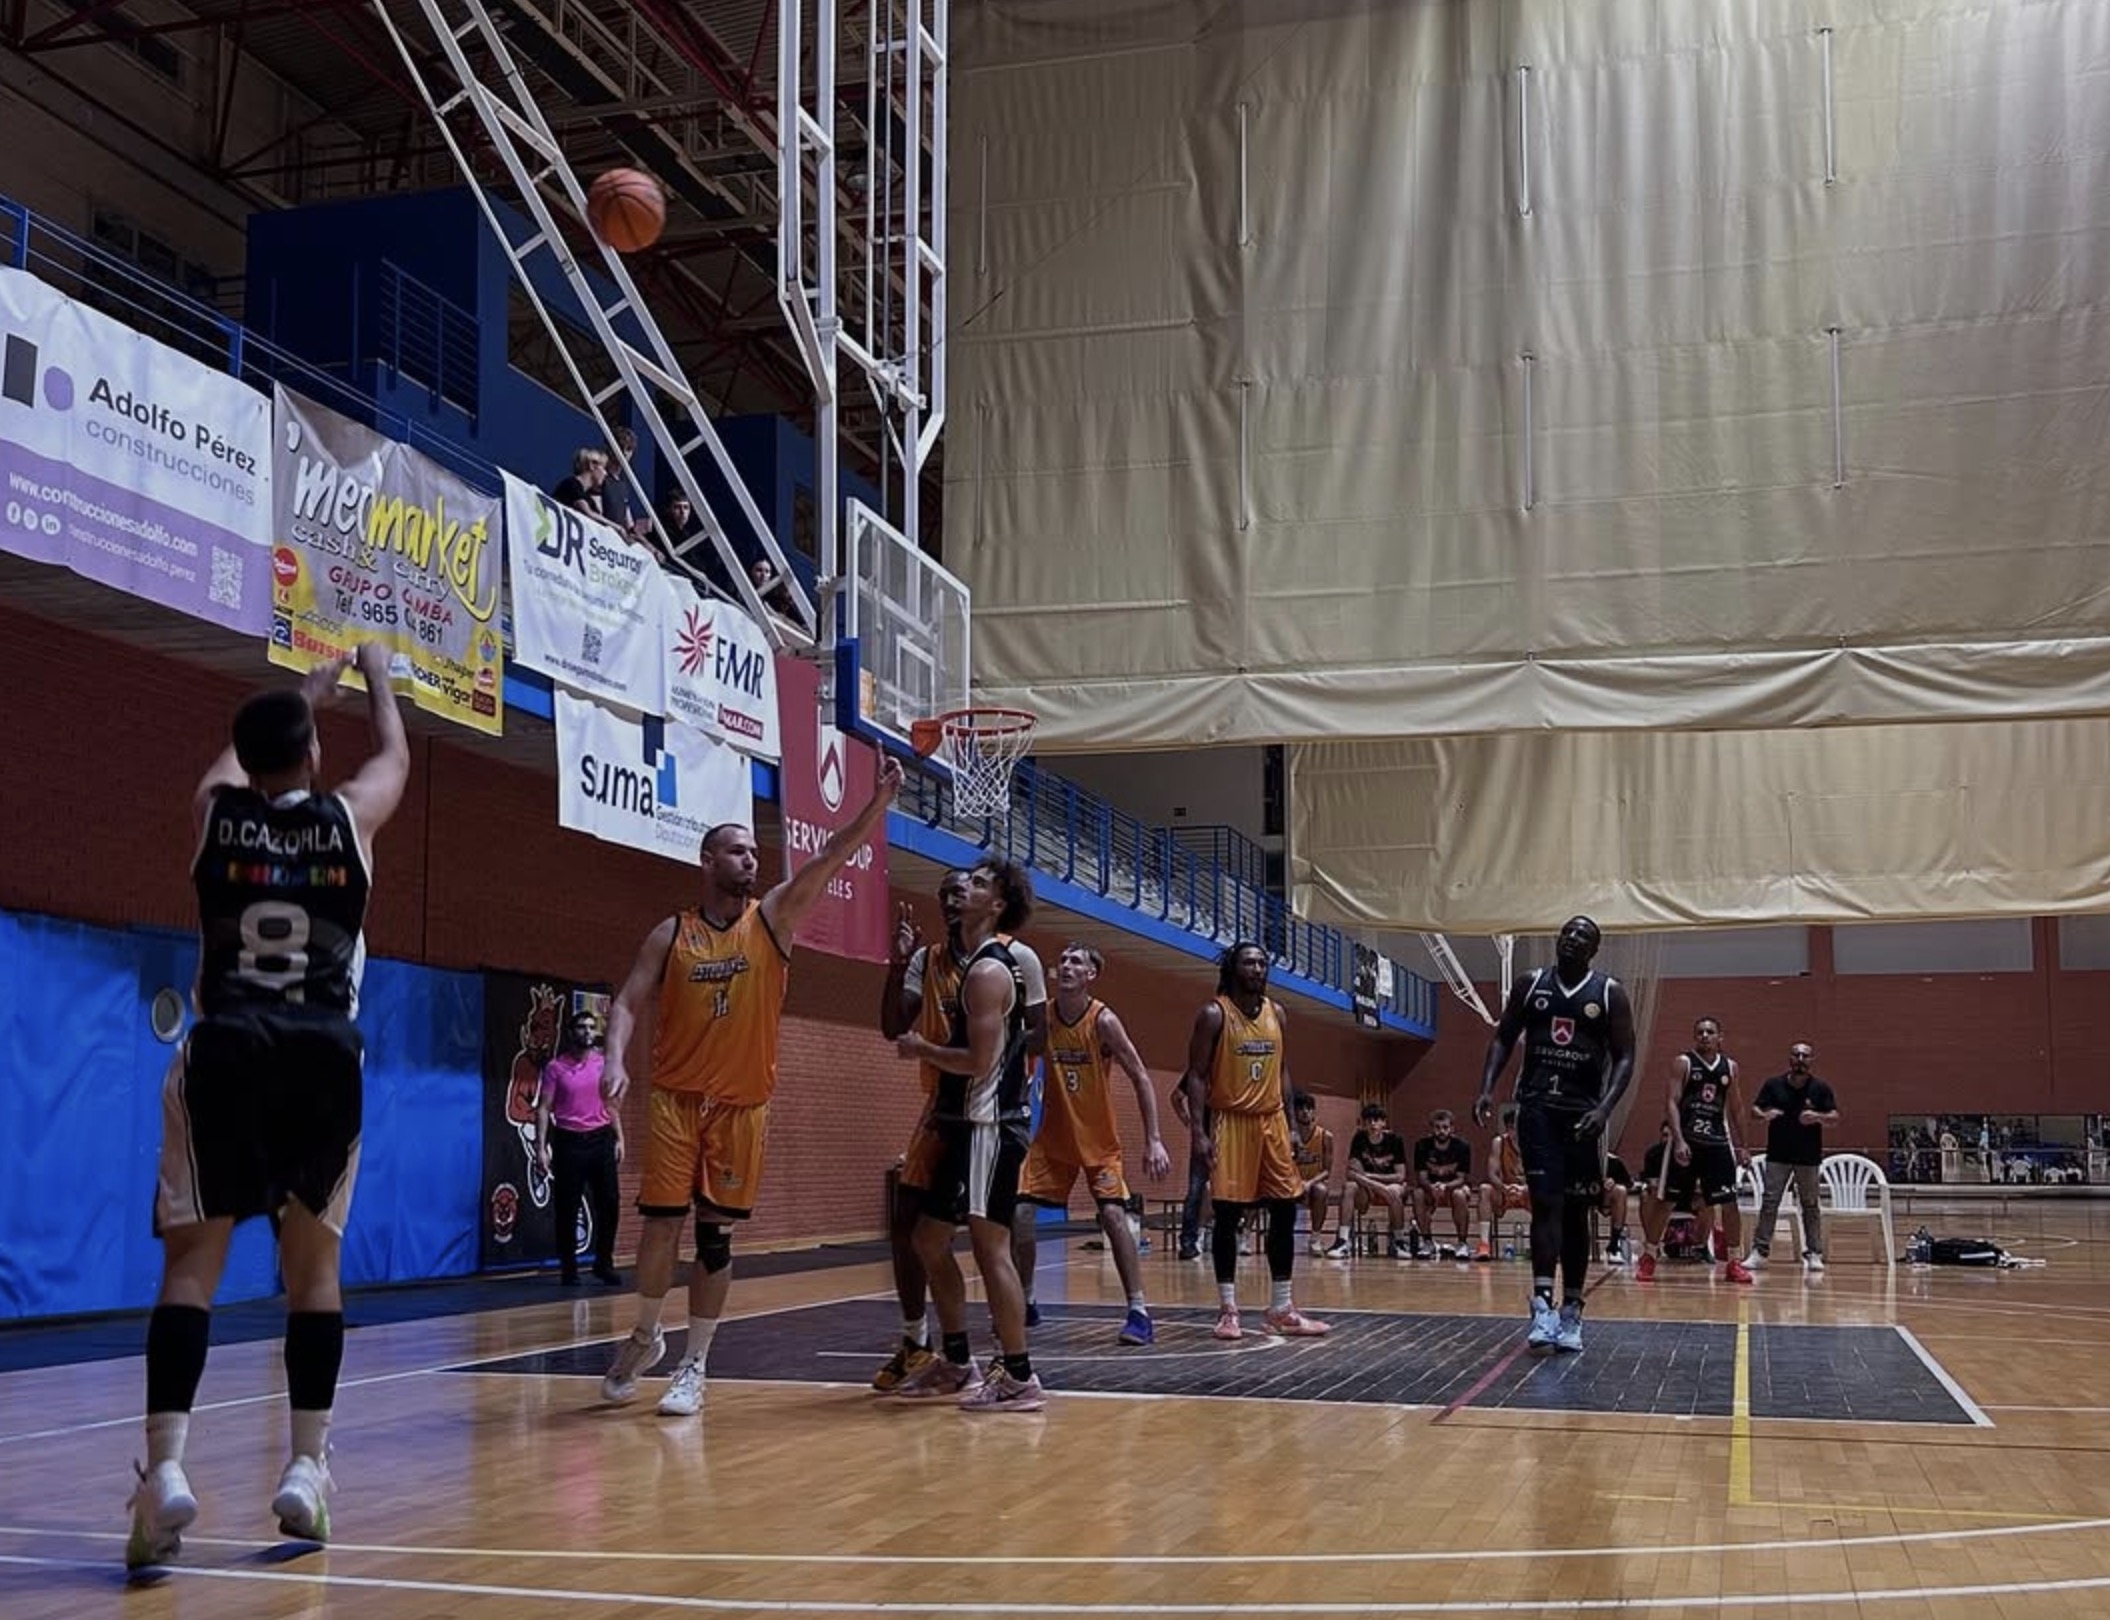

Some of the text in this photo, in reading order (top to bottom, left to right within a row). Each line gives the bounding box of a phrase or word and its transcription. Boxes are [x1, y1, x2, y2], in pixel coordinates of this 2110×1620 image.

[88, 377, 256, 476] Adolfo Pérez
[86, 419, 254, 506] construcciones
[536, 491, 586, 577] DR
[361, 601, 399, 625] 965
[238, 900, 311, 990] 8
[1066, 1071, 1079, 1091] 3
[1547, 1073, 1563, 1095] 1
[1692, 1119, 1713, 1136] 22
